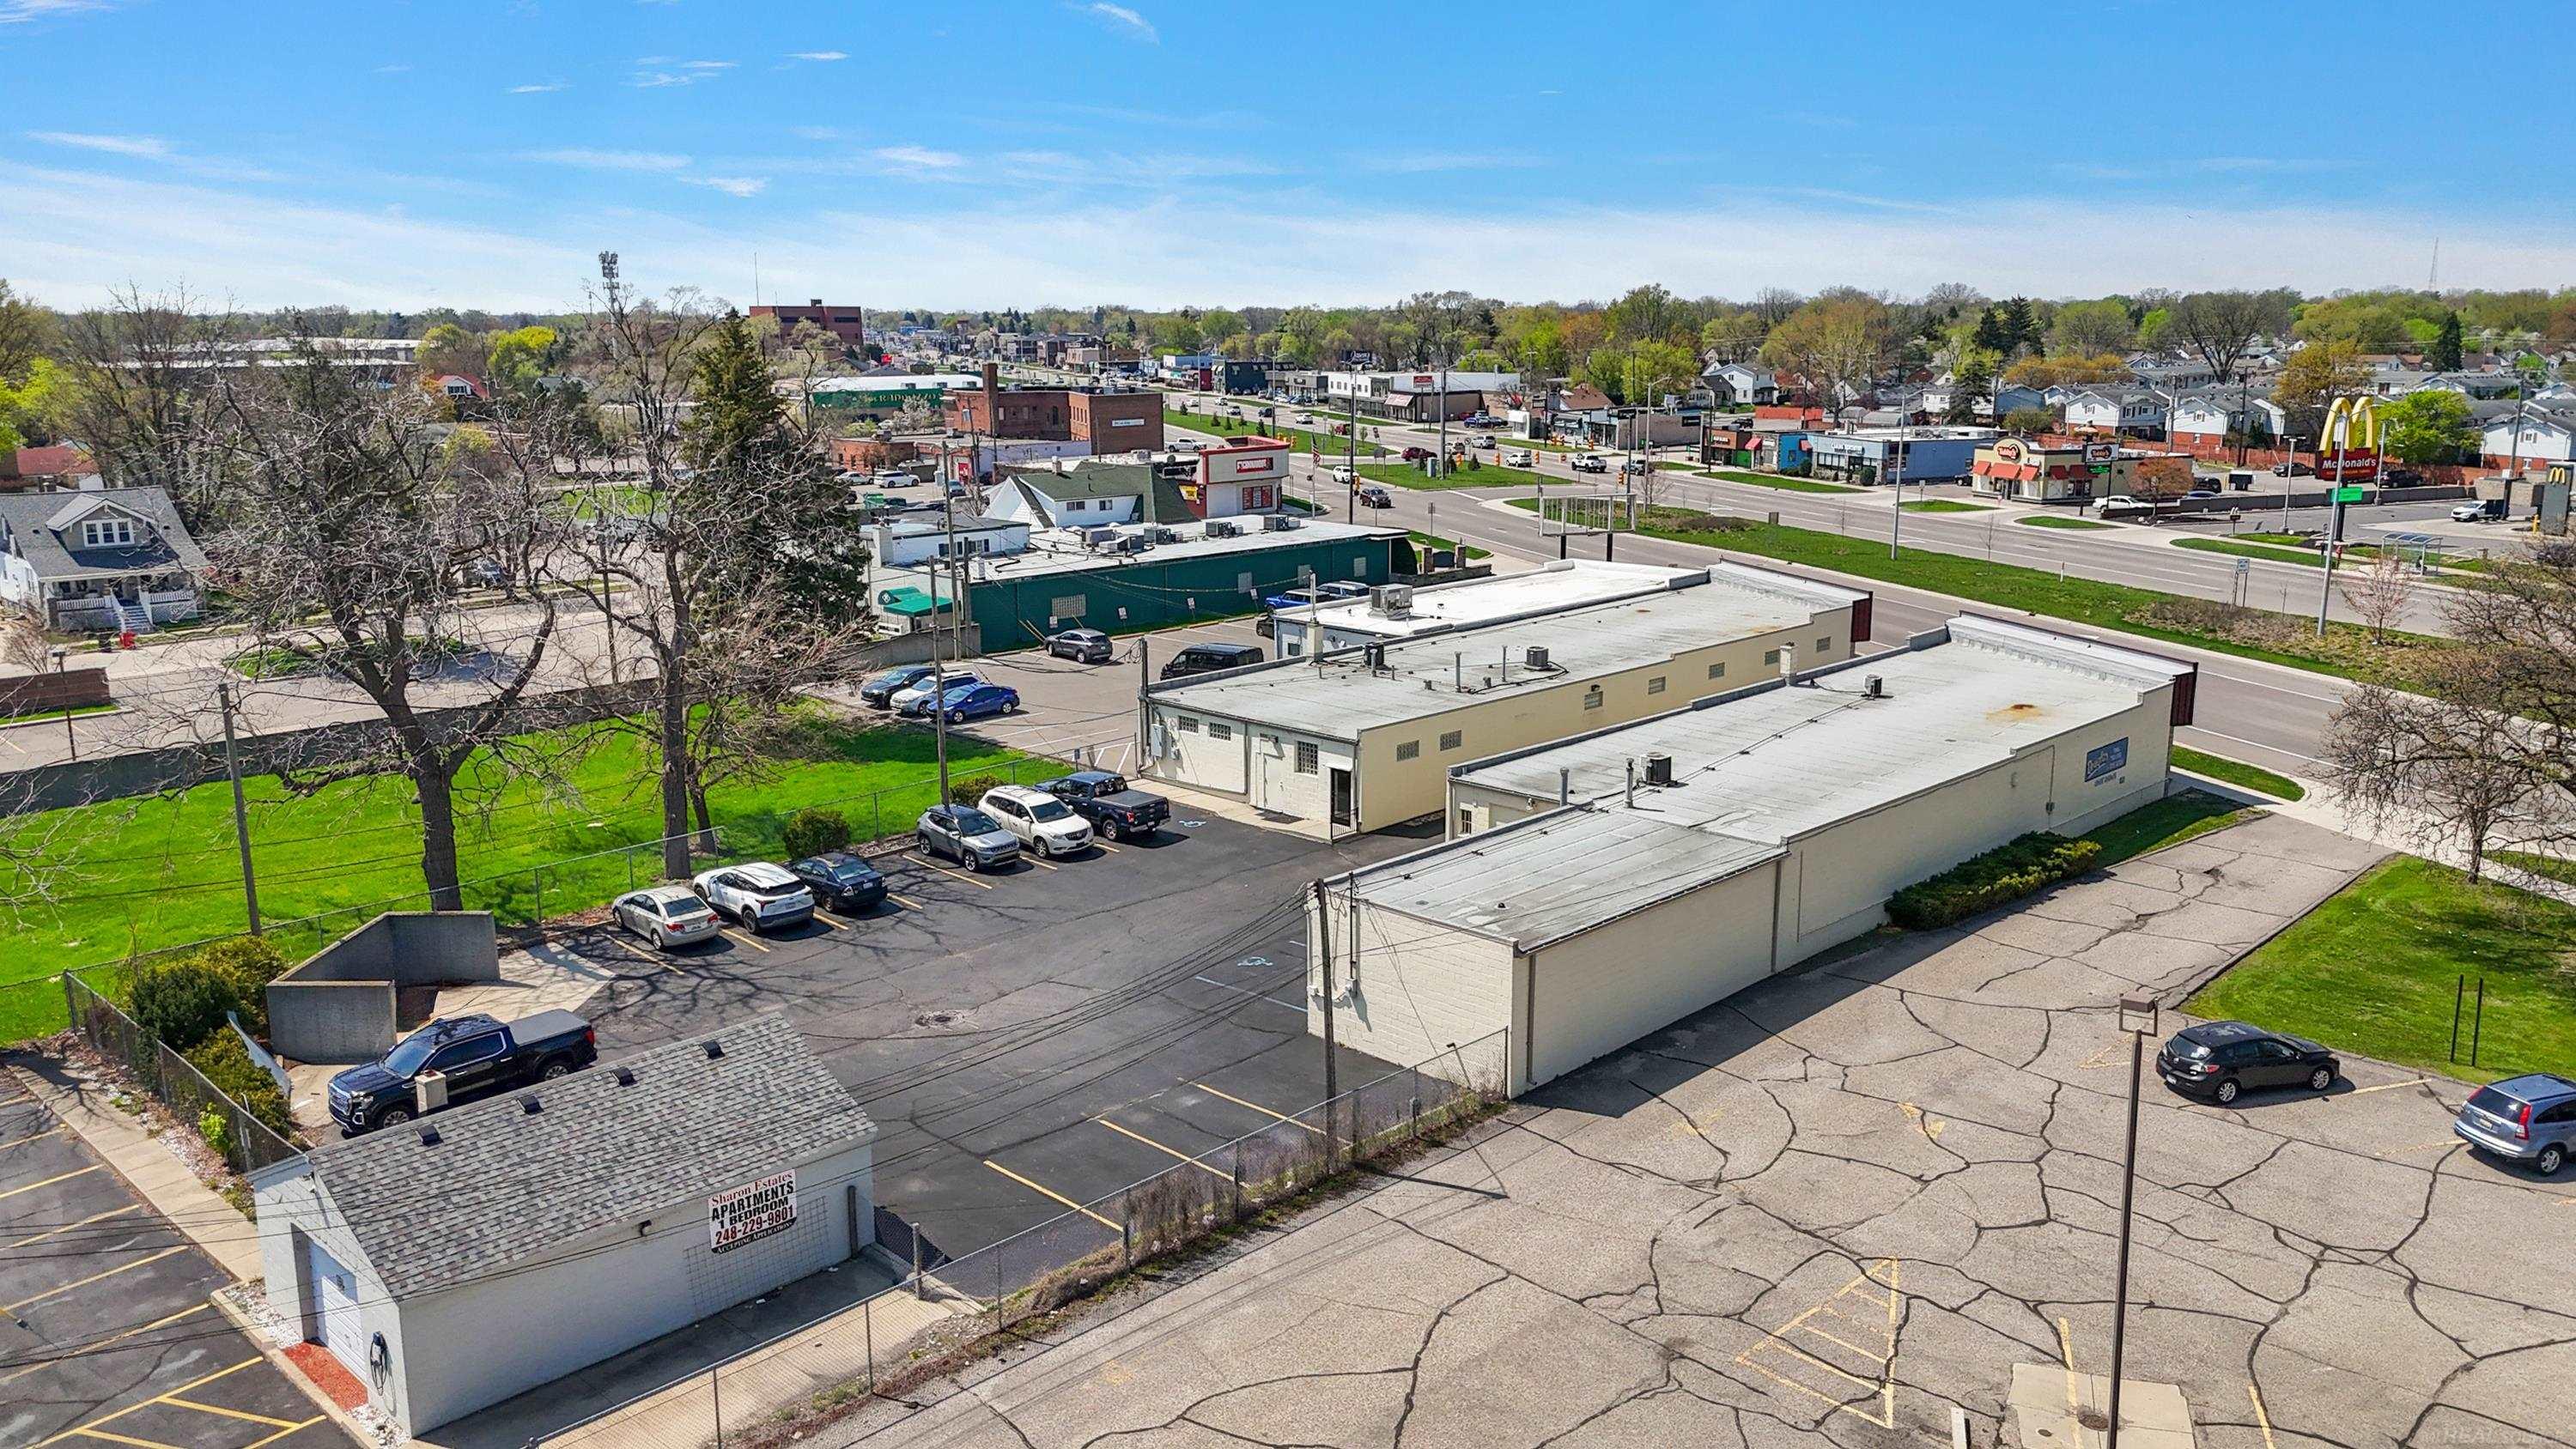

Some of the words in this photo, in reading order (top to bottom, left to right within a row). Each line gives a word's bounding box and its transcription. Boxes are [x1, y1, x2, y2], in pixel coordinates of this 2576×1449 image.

[712, 1186, 751, 1206] Sharon
[755, 1172, 793, 1191] Estates
[712, 1180, 793, 1221] APARTMENTS
[715, 1204, 793, 1245] 248-229-9801
[718, 1220, 725, 1228] 1
[730, 1197, 788, 1226] BEDROOM
